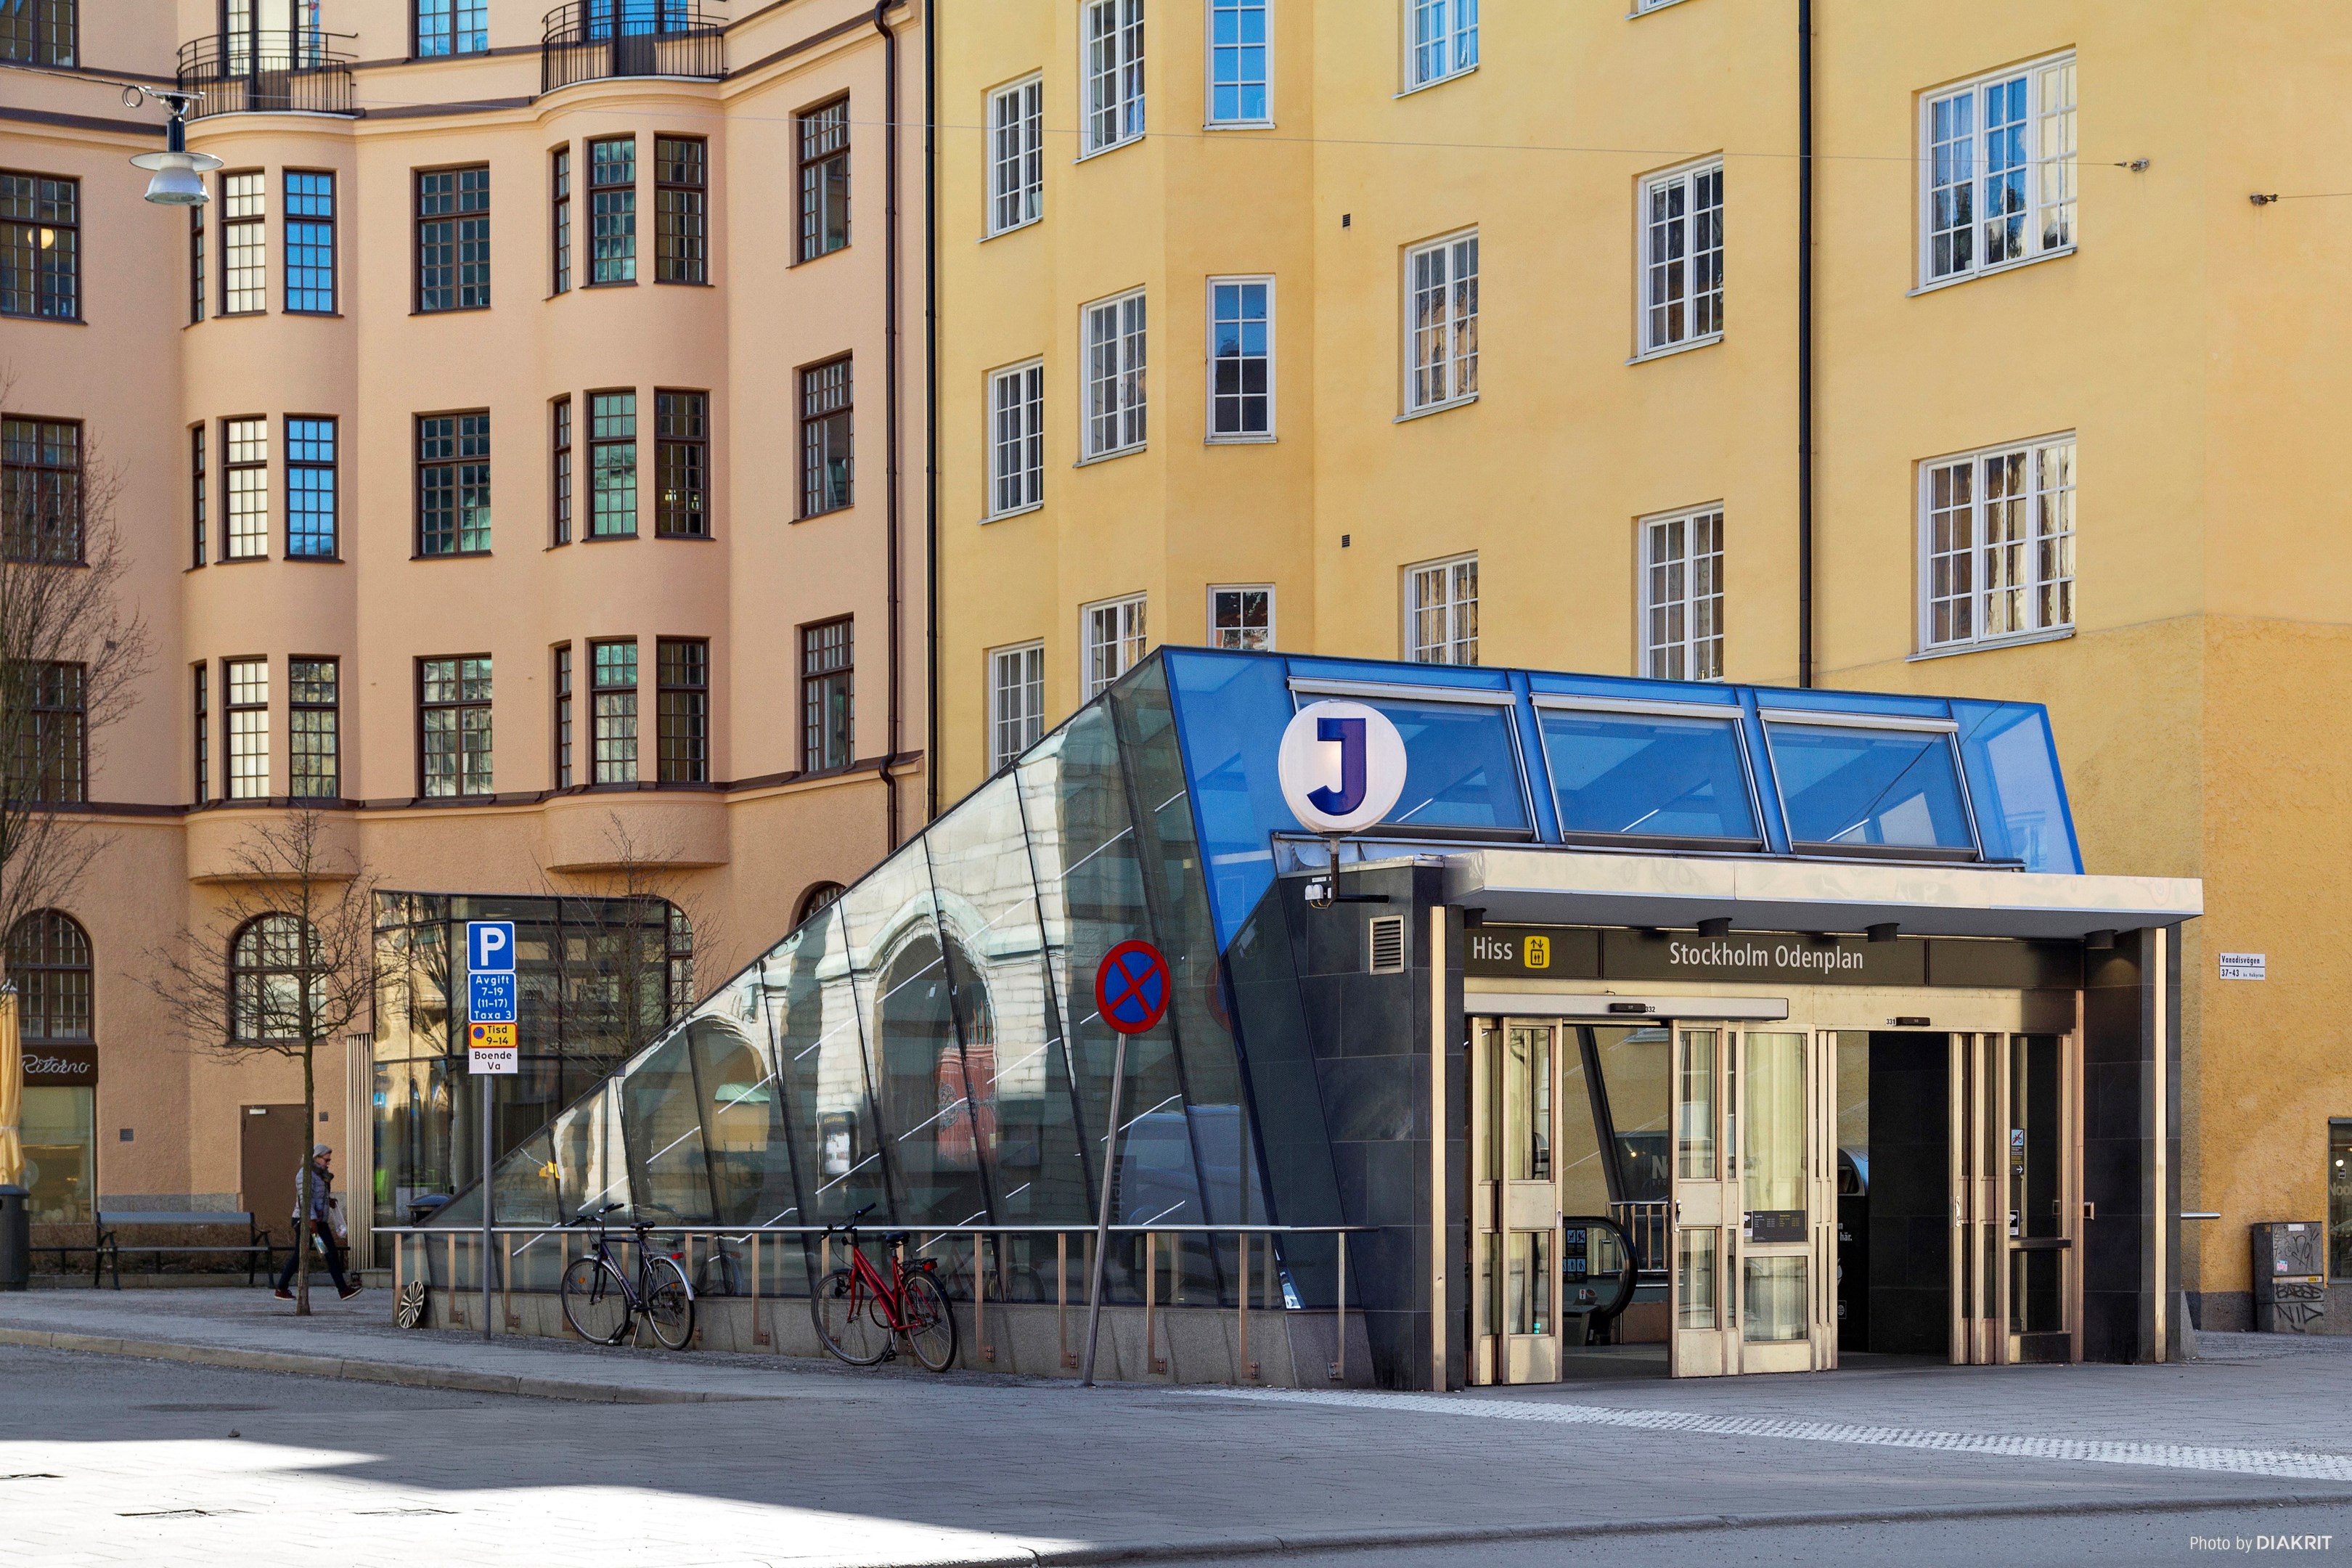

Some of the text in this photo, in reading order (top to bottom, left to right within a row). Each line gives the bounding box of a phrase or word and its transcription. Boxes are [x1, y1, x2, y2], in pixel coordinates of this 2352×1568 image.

[1306, 717, 1367, 816] J
[480, 927, 506, 966] P
[1473, 936, 1513, 960] Hiss
[1670, 942, 1863, 973] Stockholm Odenplan
[2221, 955, 2260, 965] Vanadisvägen
[475, 976, 510, 986] Avgift
[481, 987, 504, 996] 7-19
[478, 998, 508, 1009] (11-17)
[474, 1010, 512, 1019] Taxa 3
[487, 1025, 507, 1034] Tisd
[486, 1037, 509, 1045] 9-14
[474, 1051, 512, 1060] Boende
[488, 1061, 501, 1070] Va
[1839, 1232, 1853, 1241] här.
